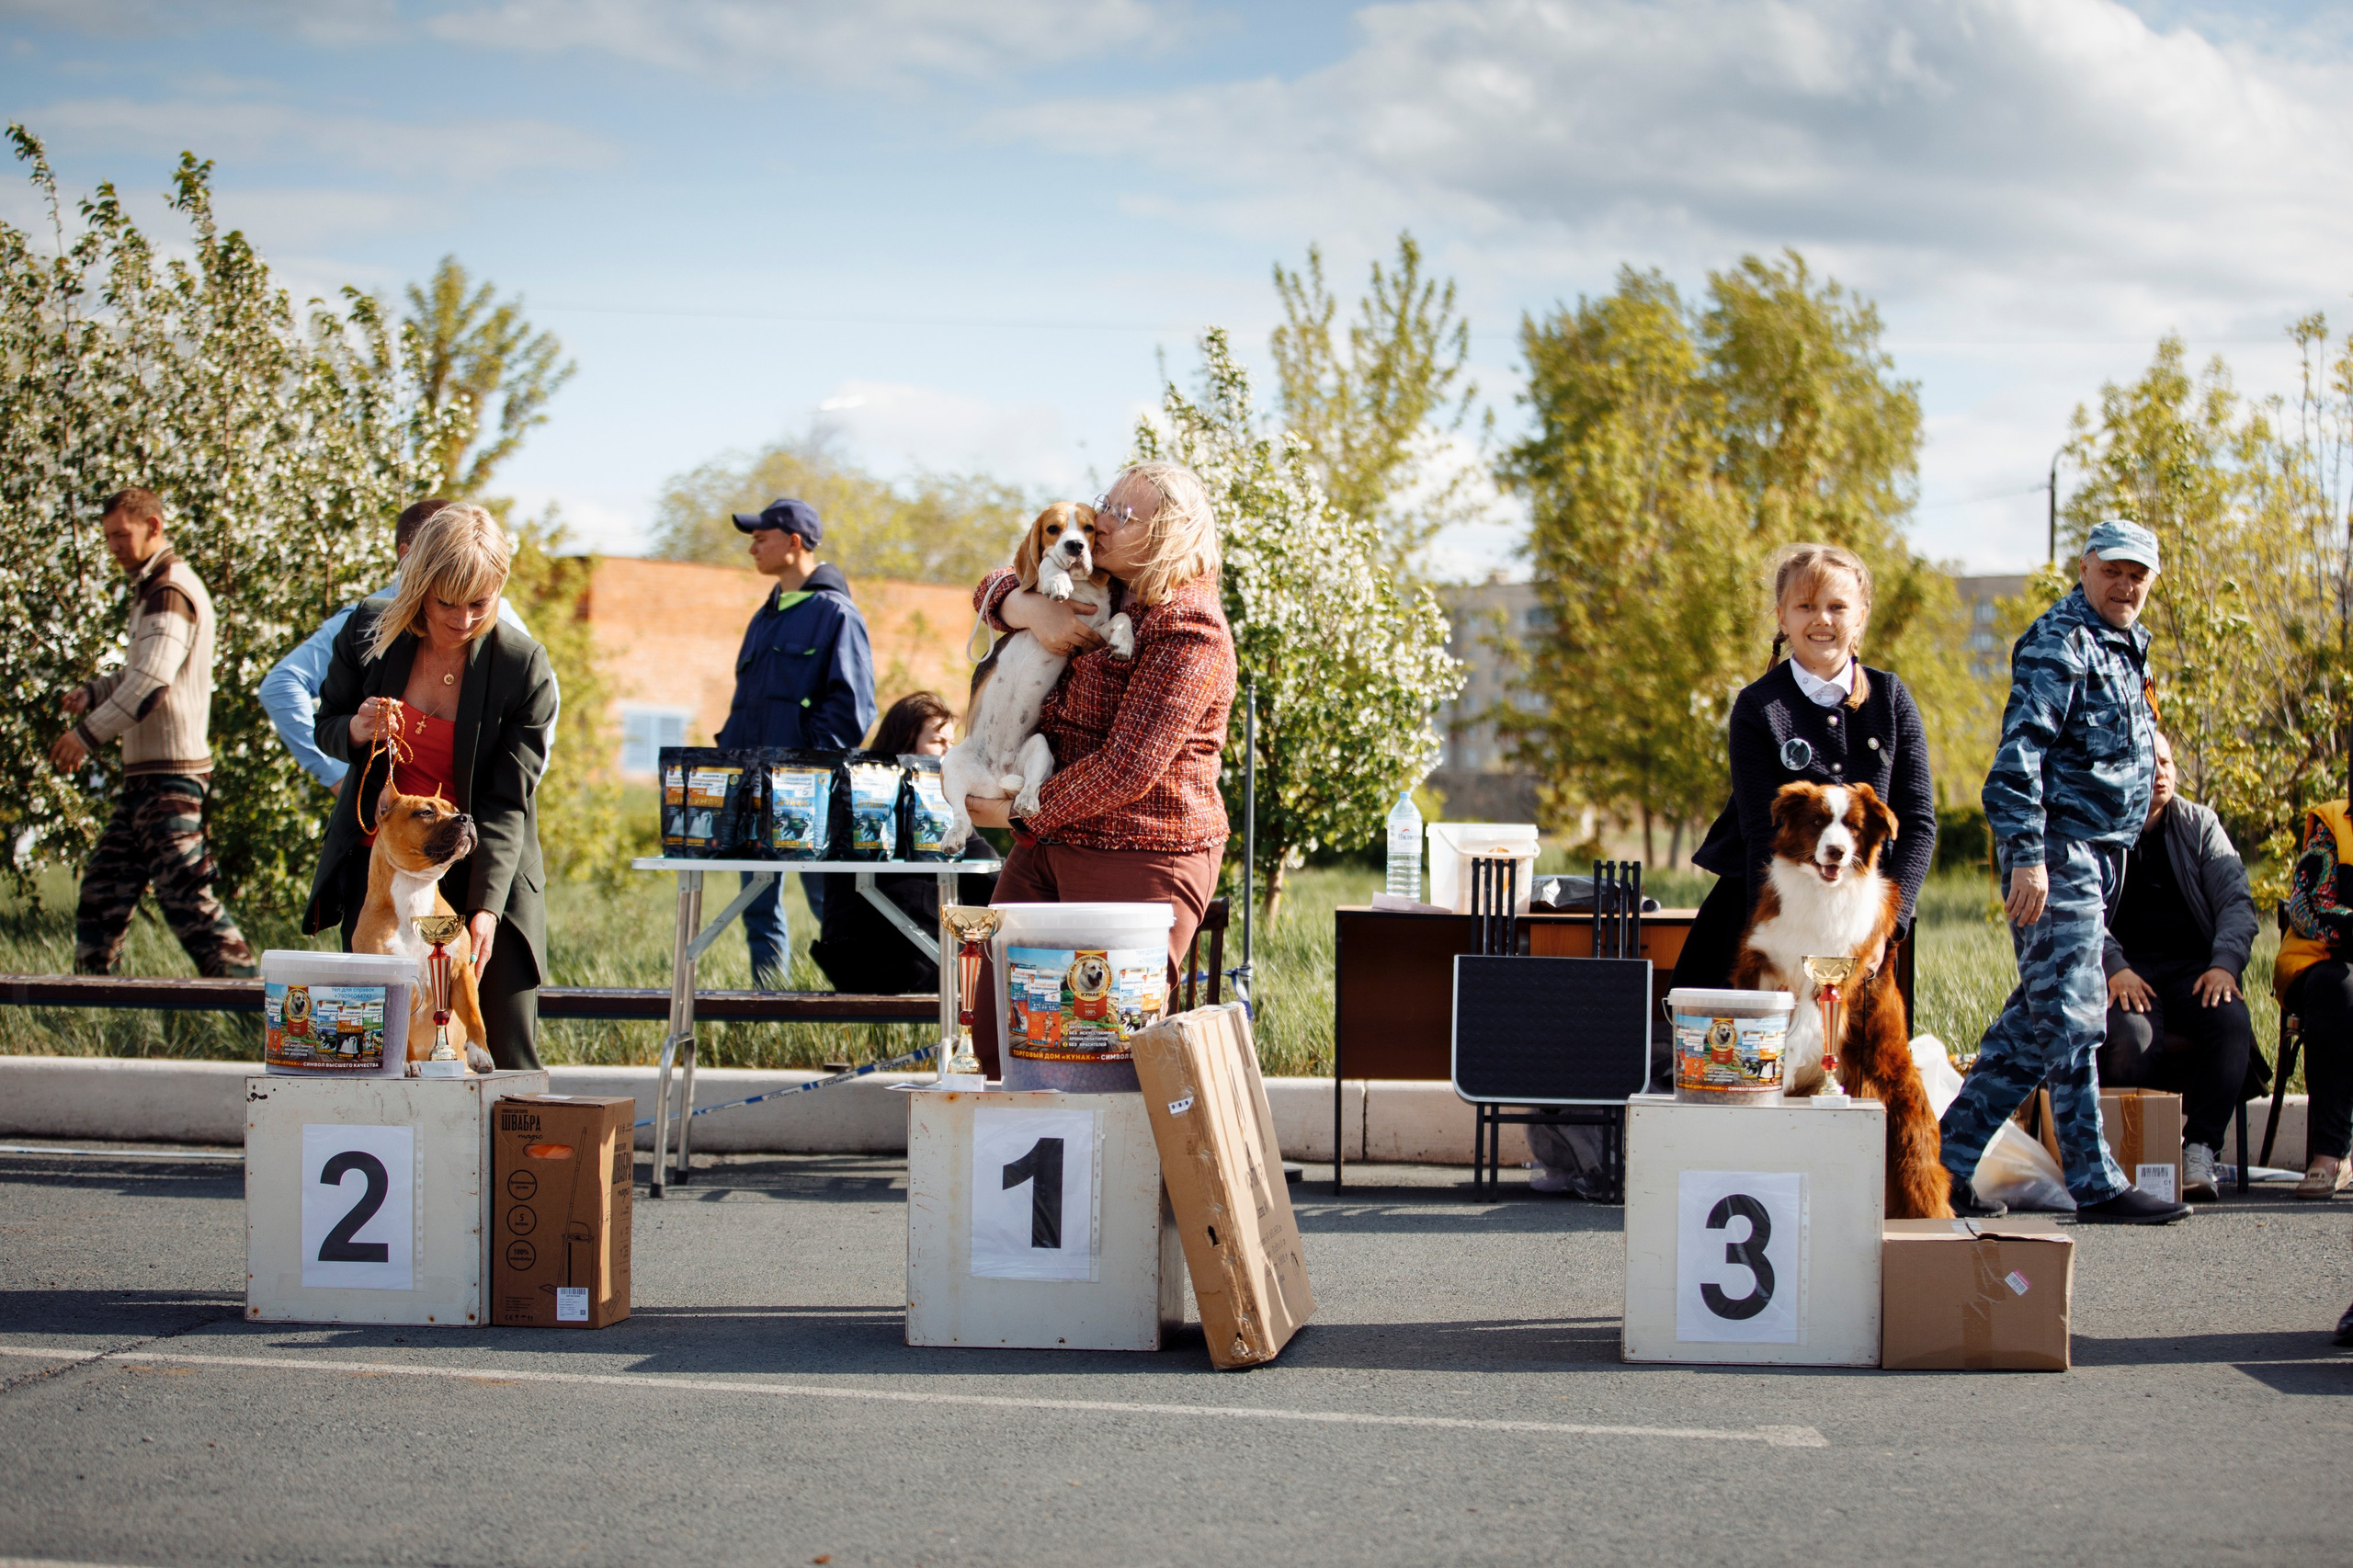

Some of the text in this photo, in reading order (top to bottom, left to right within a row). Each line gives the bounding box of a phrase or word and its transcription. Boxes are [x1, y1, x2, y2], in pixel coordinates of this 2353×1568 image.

[1013, 1050, 1043, 1059] ТОРГОВЫЙ
[502, 1114, 540, 1131] ШВАБРА
[517, 1132, 543, 1142] magic
[1002, 1137, 1064, 1248] 1
[318, 1151, 390, 1263] 2
[519, 1213, 524, 1221] 5
[1699, 1193, 1775, 1320] 3
